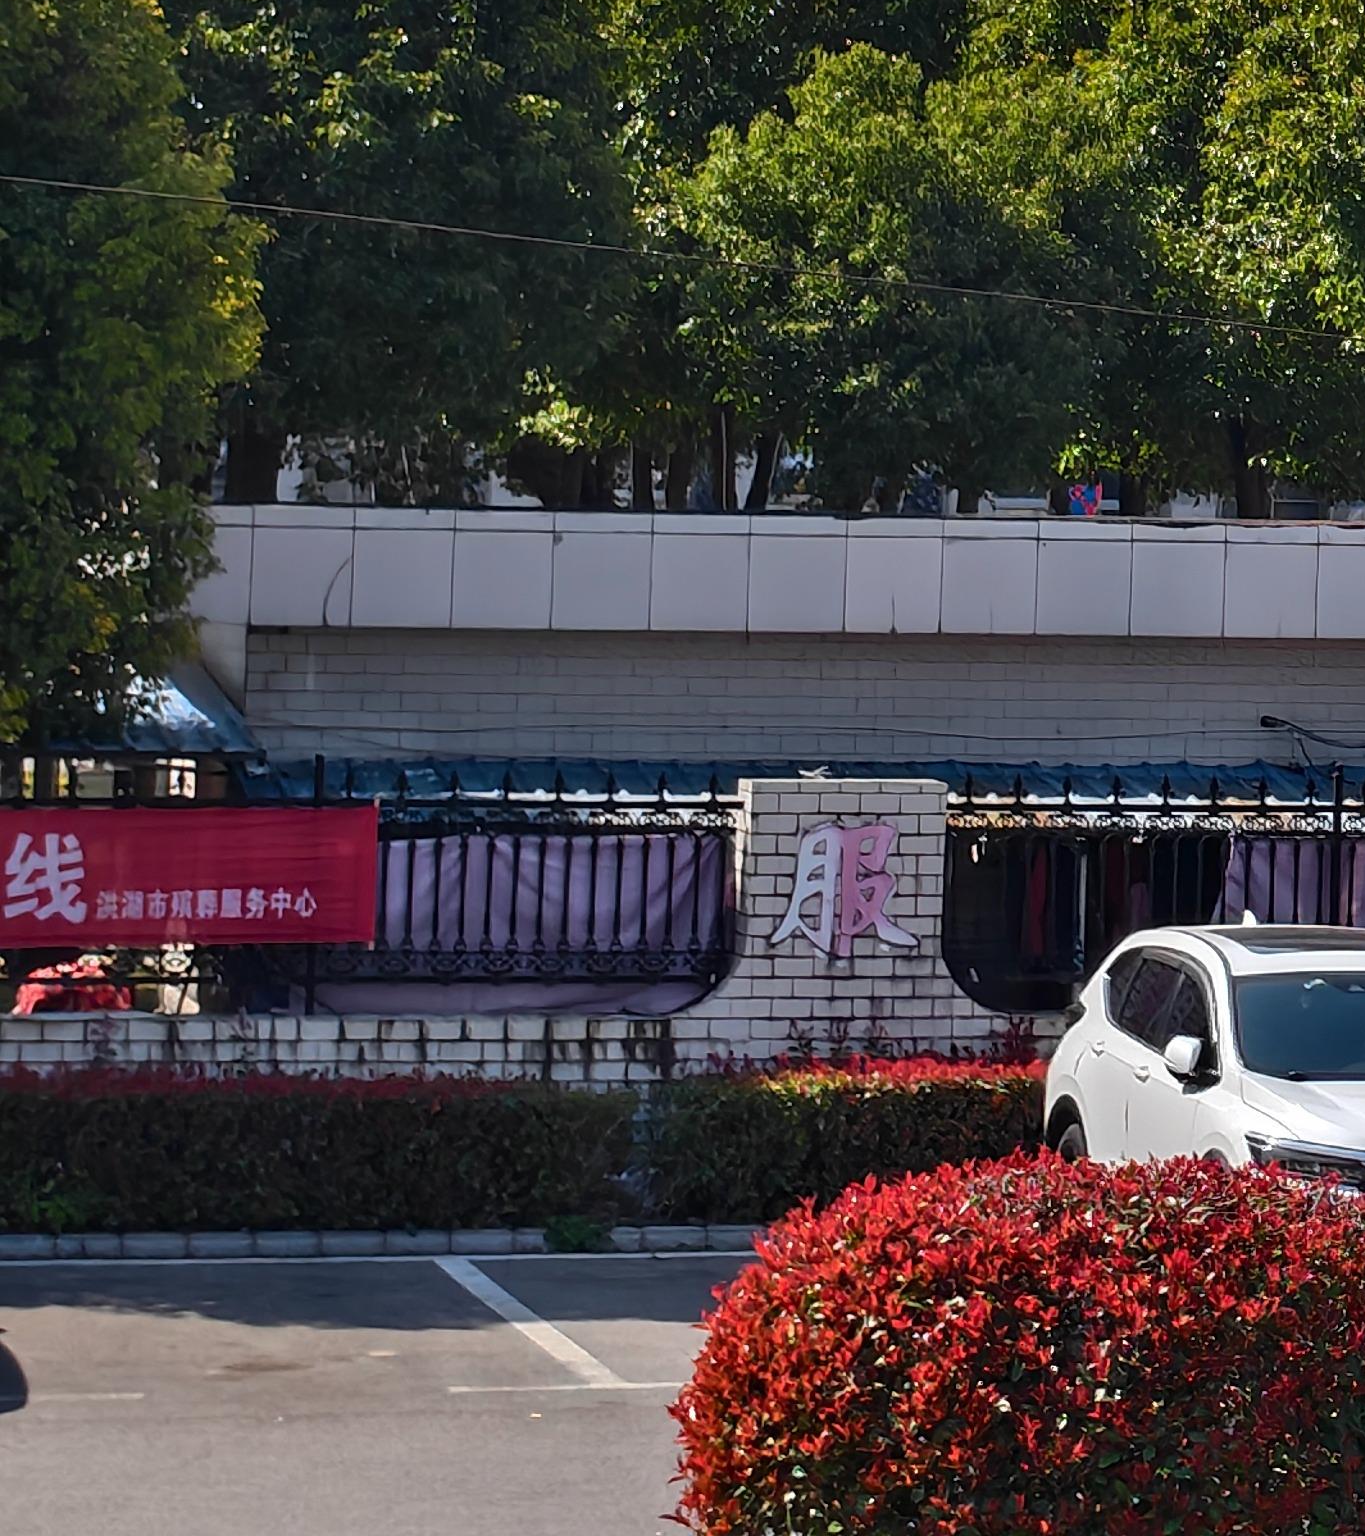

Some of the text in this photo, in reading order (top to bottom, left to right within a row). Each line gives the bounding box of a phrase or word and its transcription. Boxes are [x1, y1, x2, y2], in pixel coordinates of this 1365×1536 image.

[3, 832, 88, 924] 线
[96, 887, 318, 920] 洪湖市殡葬服务中心
[770, 822, 920, 958] 服
